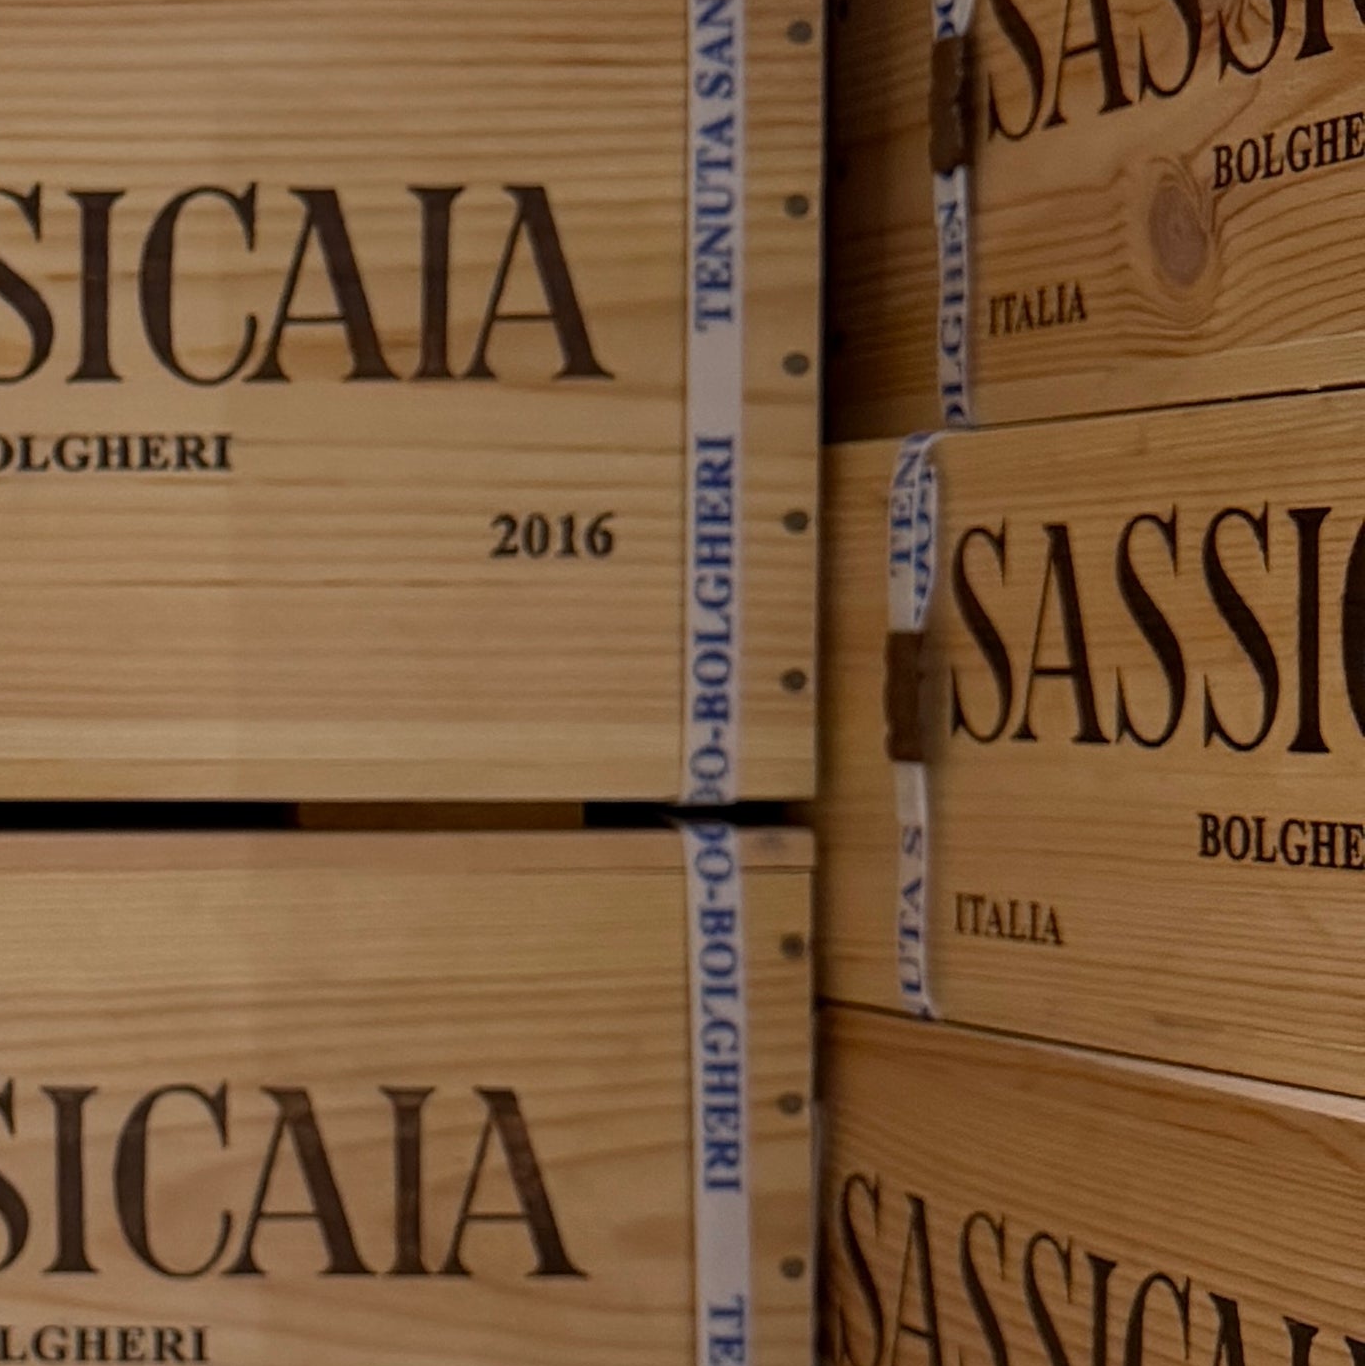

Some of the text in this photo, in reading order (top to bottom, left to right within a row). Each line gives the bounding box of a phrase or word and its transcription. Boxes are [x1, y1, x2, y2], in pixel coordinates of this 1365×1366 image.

[695, 115, 735, 332] TENUTA
[987, 282, 1087, 337] ITALIA
[490, 512, 616, 558] 2016
[950, 501, 1365, 755] SASSI
[954, 893, 1065, 946] ITALIA
